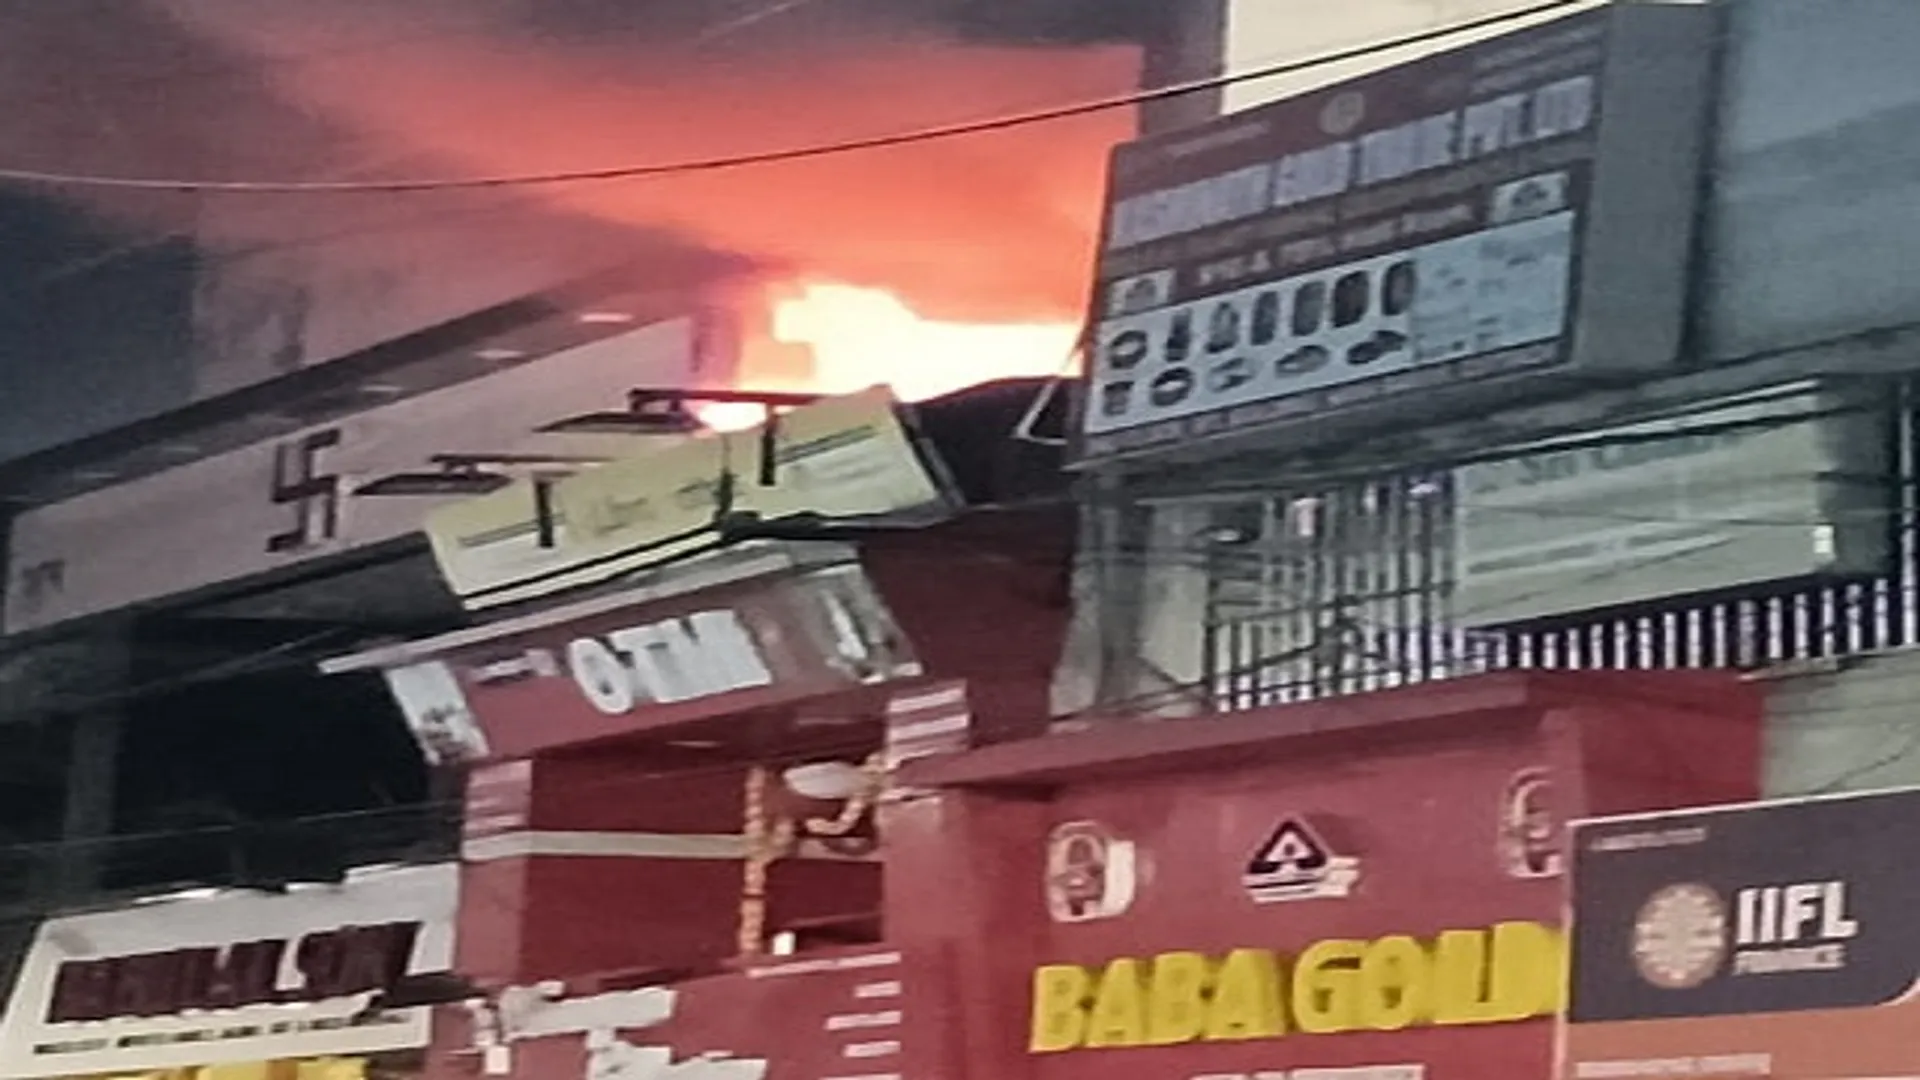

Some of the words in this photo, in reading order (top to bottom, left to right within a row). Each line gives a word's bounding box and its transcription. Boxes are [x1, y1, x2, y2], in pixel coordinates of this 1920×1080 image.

[1736, 881, 1858, 945] IIFL
[1029, 947, 1288, 1053] BABA
[1293, 920, 1567, 1034] GOLD
